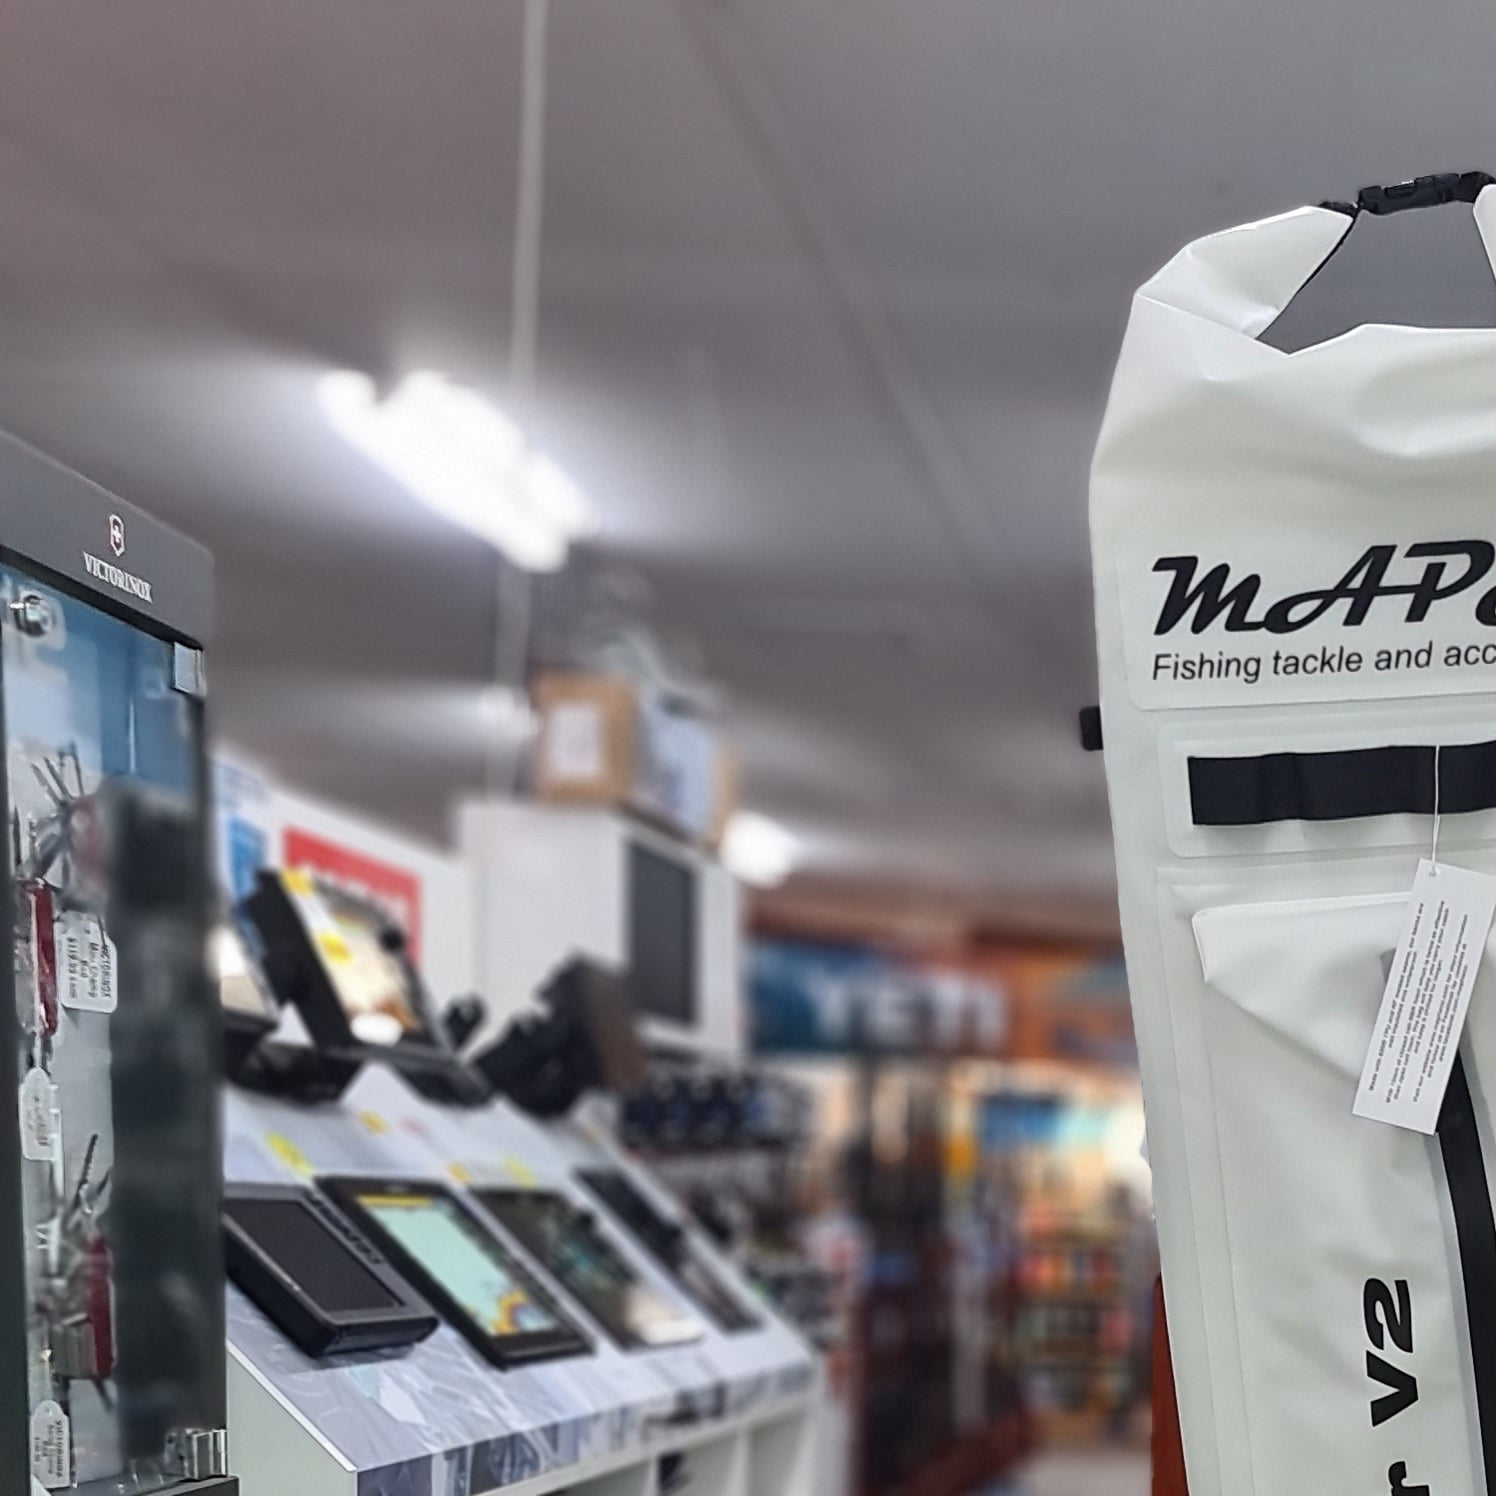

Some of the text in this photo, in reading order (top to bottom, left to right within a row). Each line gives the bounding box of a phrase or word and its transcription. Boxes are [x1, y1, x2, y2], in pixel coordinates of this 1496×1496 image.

[83, 551, 153, 604] VICTORINOX
[1153, 652, 1261, 684] Fishing
[1272, 645, 1364, 677] tackle
[1375, 640, 1434, 672] and
[1362, 1277, 1419, 1427] V2
